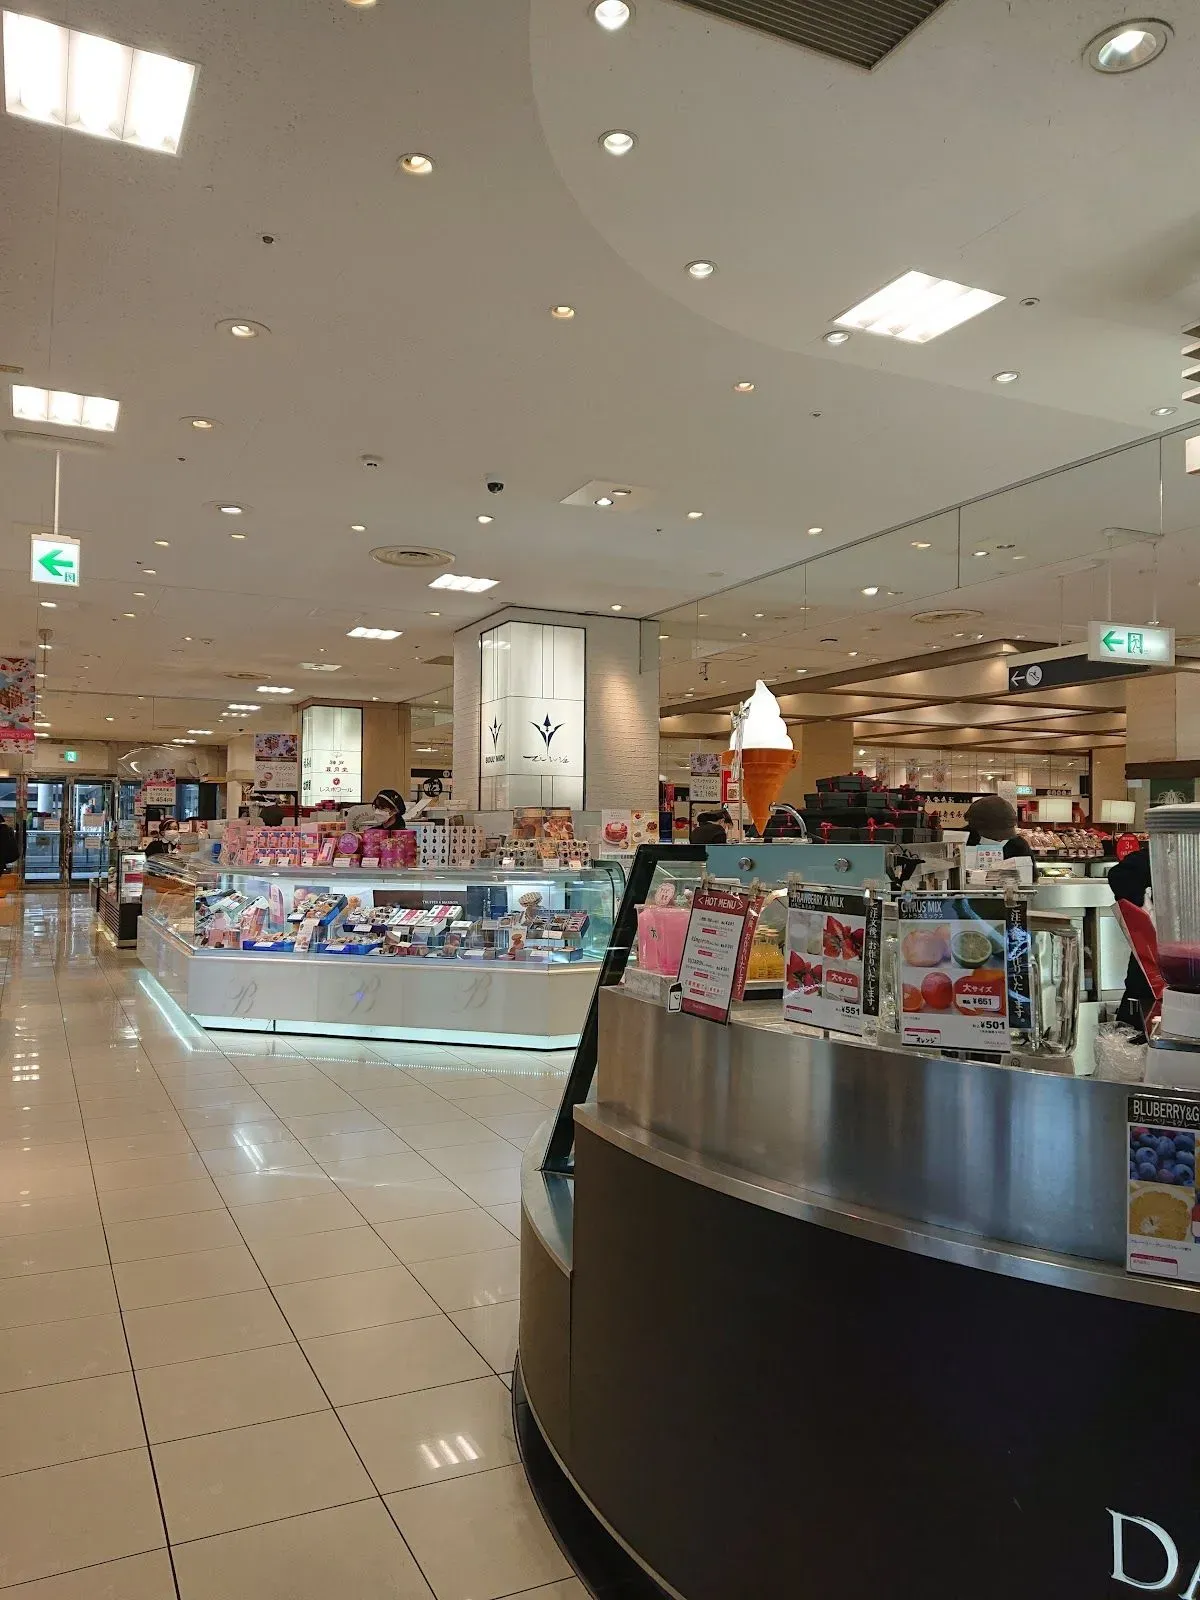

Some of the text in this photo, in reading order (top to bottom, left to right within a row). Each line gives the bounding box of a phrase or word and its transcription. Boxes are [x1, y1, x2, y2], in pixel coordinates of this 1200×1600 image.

[704, 896, 737, 910] HOT MENU
[830, 895, 845, 908] MILK
[927, 901, 943, 913] MIX
[831, 973, 853, 984] 大サイズ
[962, 983, 992, 993] 大サイズ
[841, 1005, 860, 1016] ¥551
[980, 1021, 1006, 1030] ¥501
[1105, 1506, 1200, 1600] D
